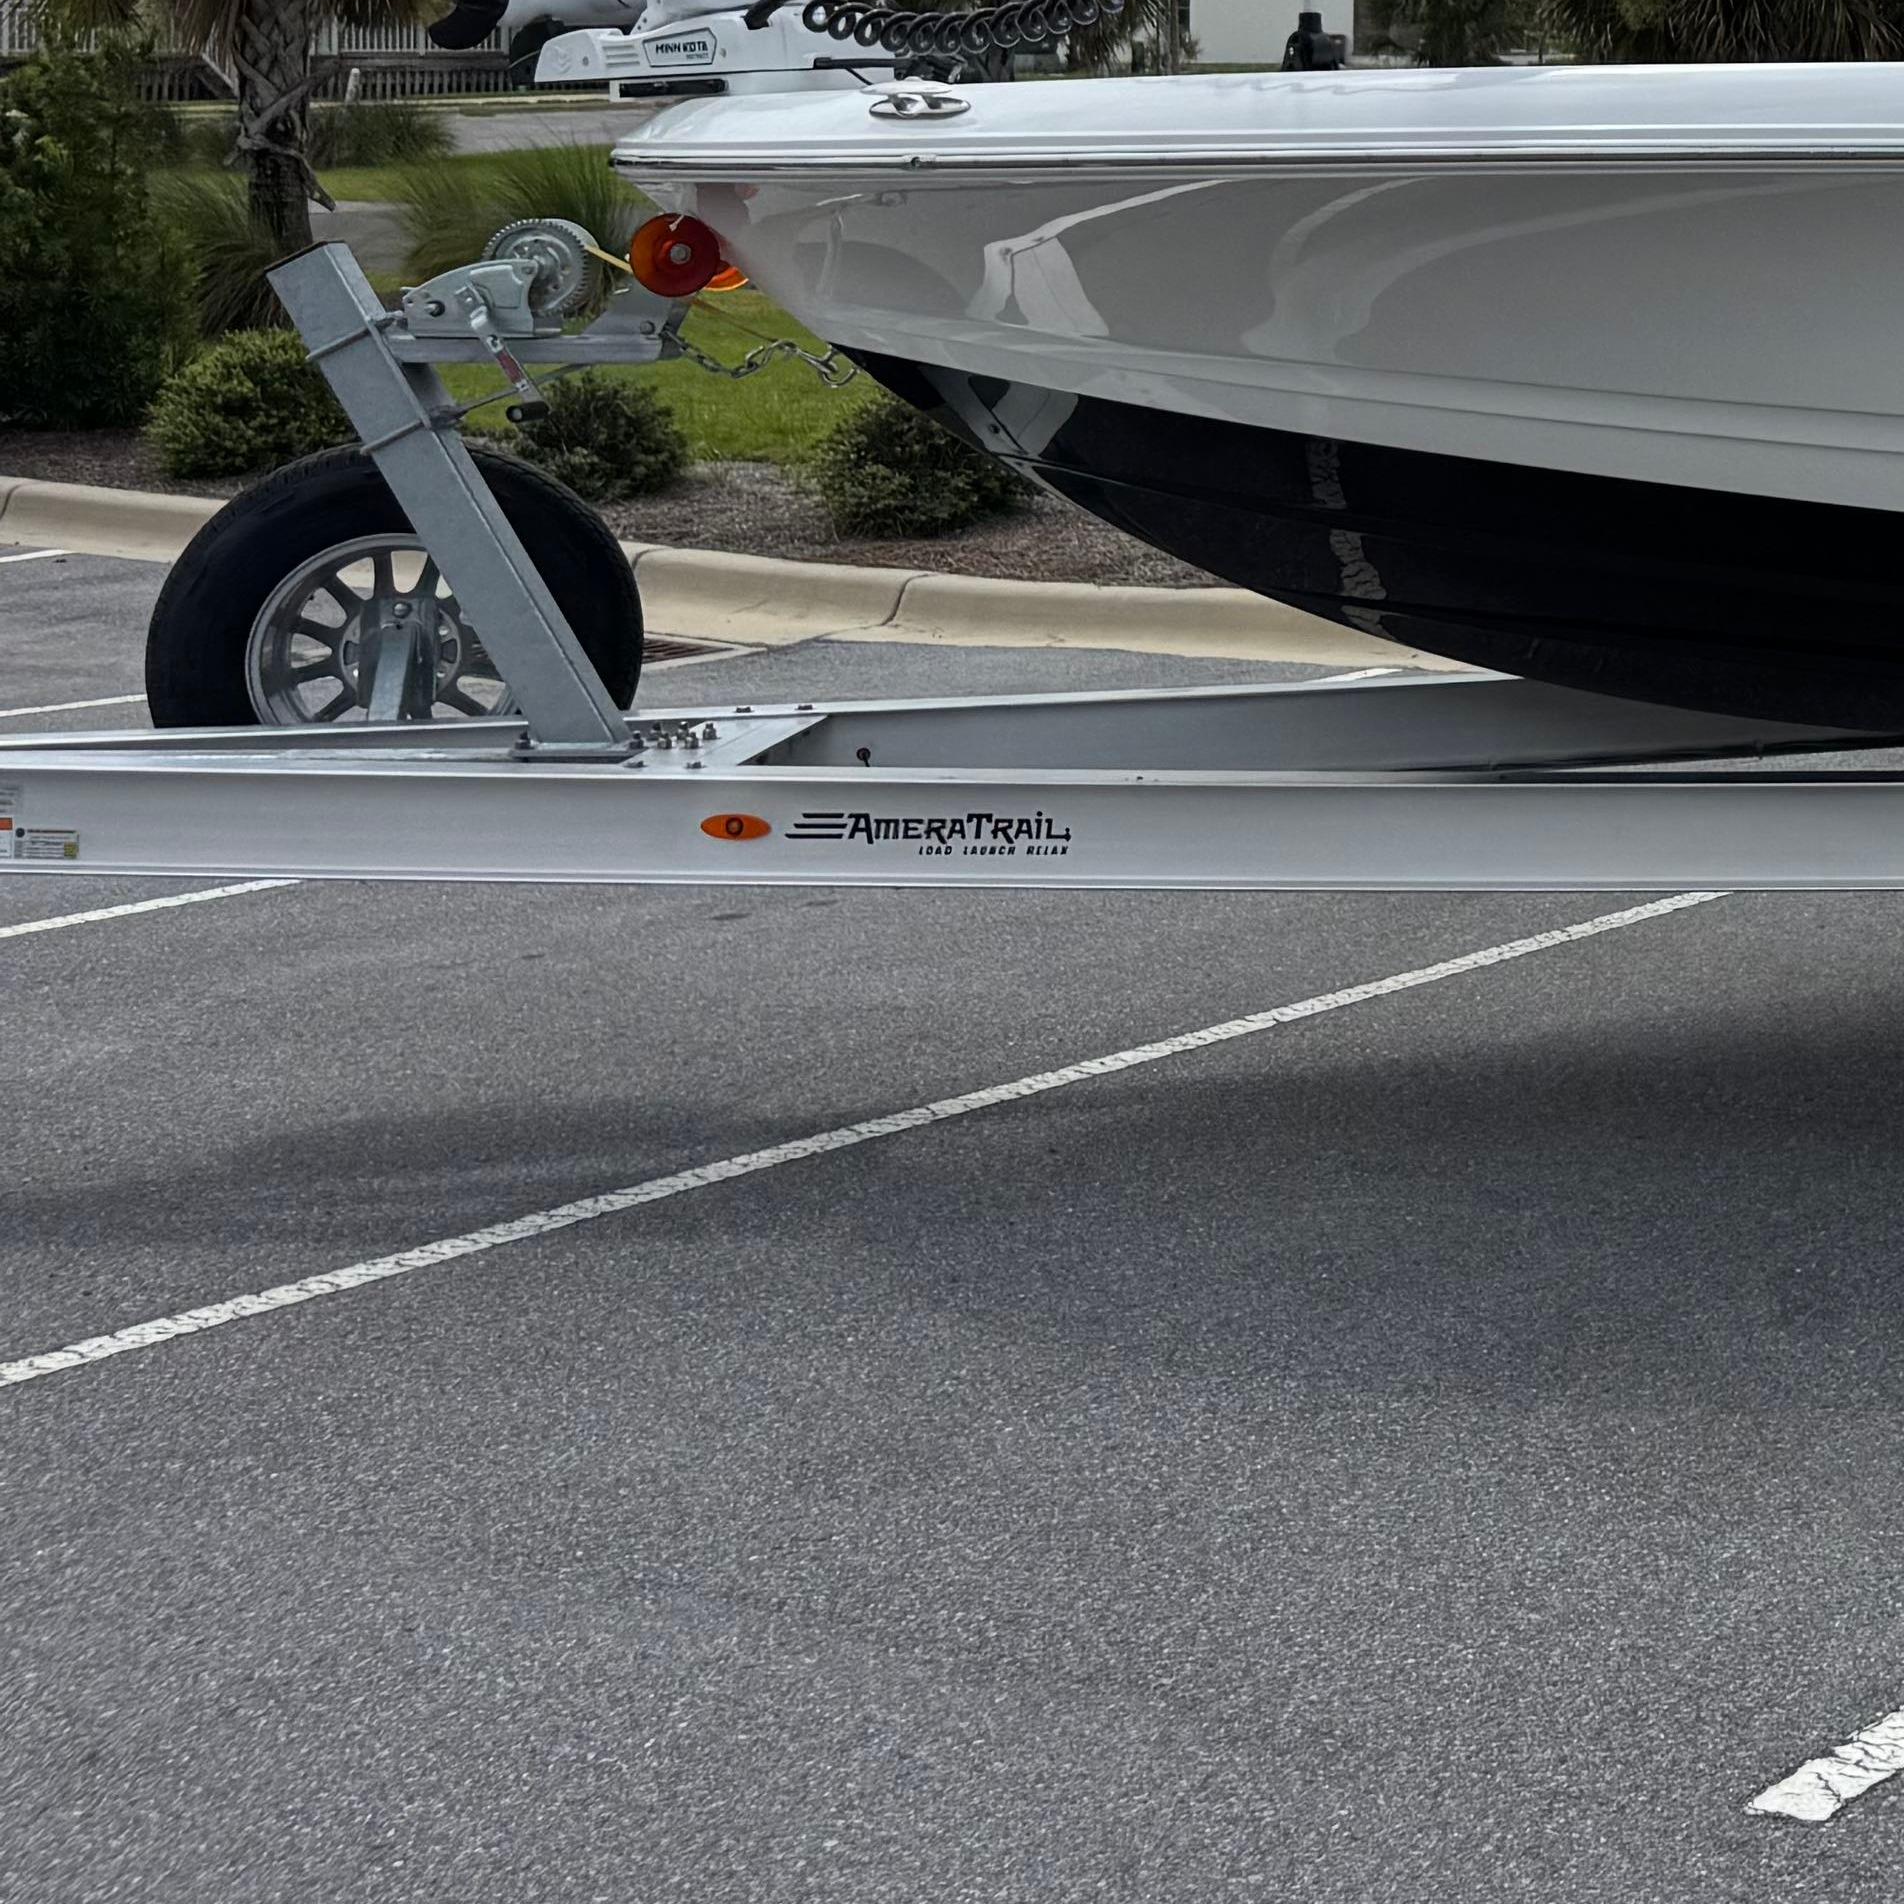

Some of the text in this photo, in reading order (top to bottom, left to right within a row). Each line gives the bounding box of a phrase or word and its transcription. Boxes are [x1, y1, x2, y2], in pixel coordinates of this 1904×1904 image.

[918, 846, 1069, 856] LOAD LAUNCH RELAX
